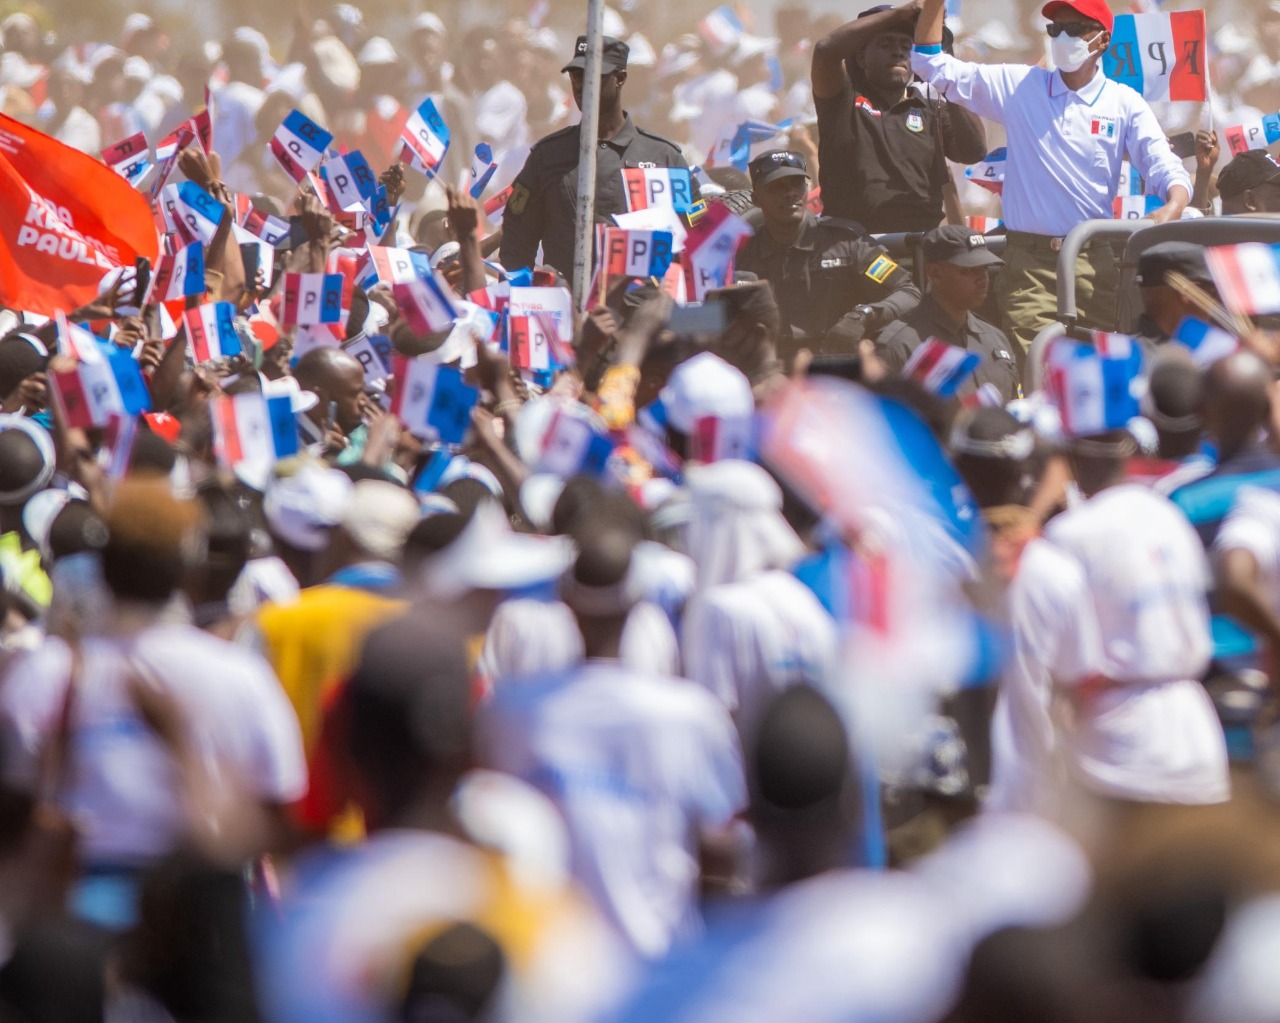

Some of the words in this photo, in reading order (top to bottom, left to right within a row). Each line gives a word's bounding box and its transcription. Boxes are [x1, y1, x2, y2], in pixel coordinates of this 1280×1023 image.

[279, 122, 322, 173] FPR
[1230, 121, 1279, 149] FPR
[627, 178, 689, 205] FPR
[611, 238, 669, 268] FPR
[285, 289, 339, 310] FPR
